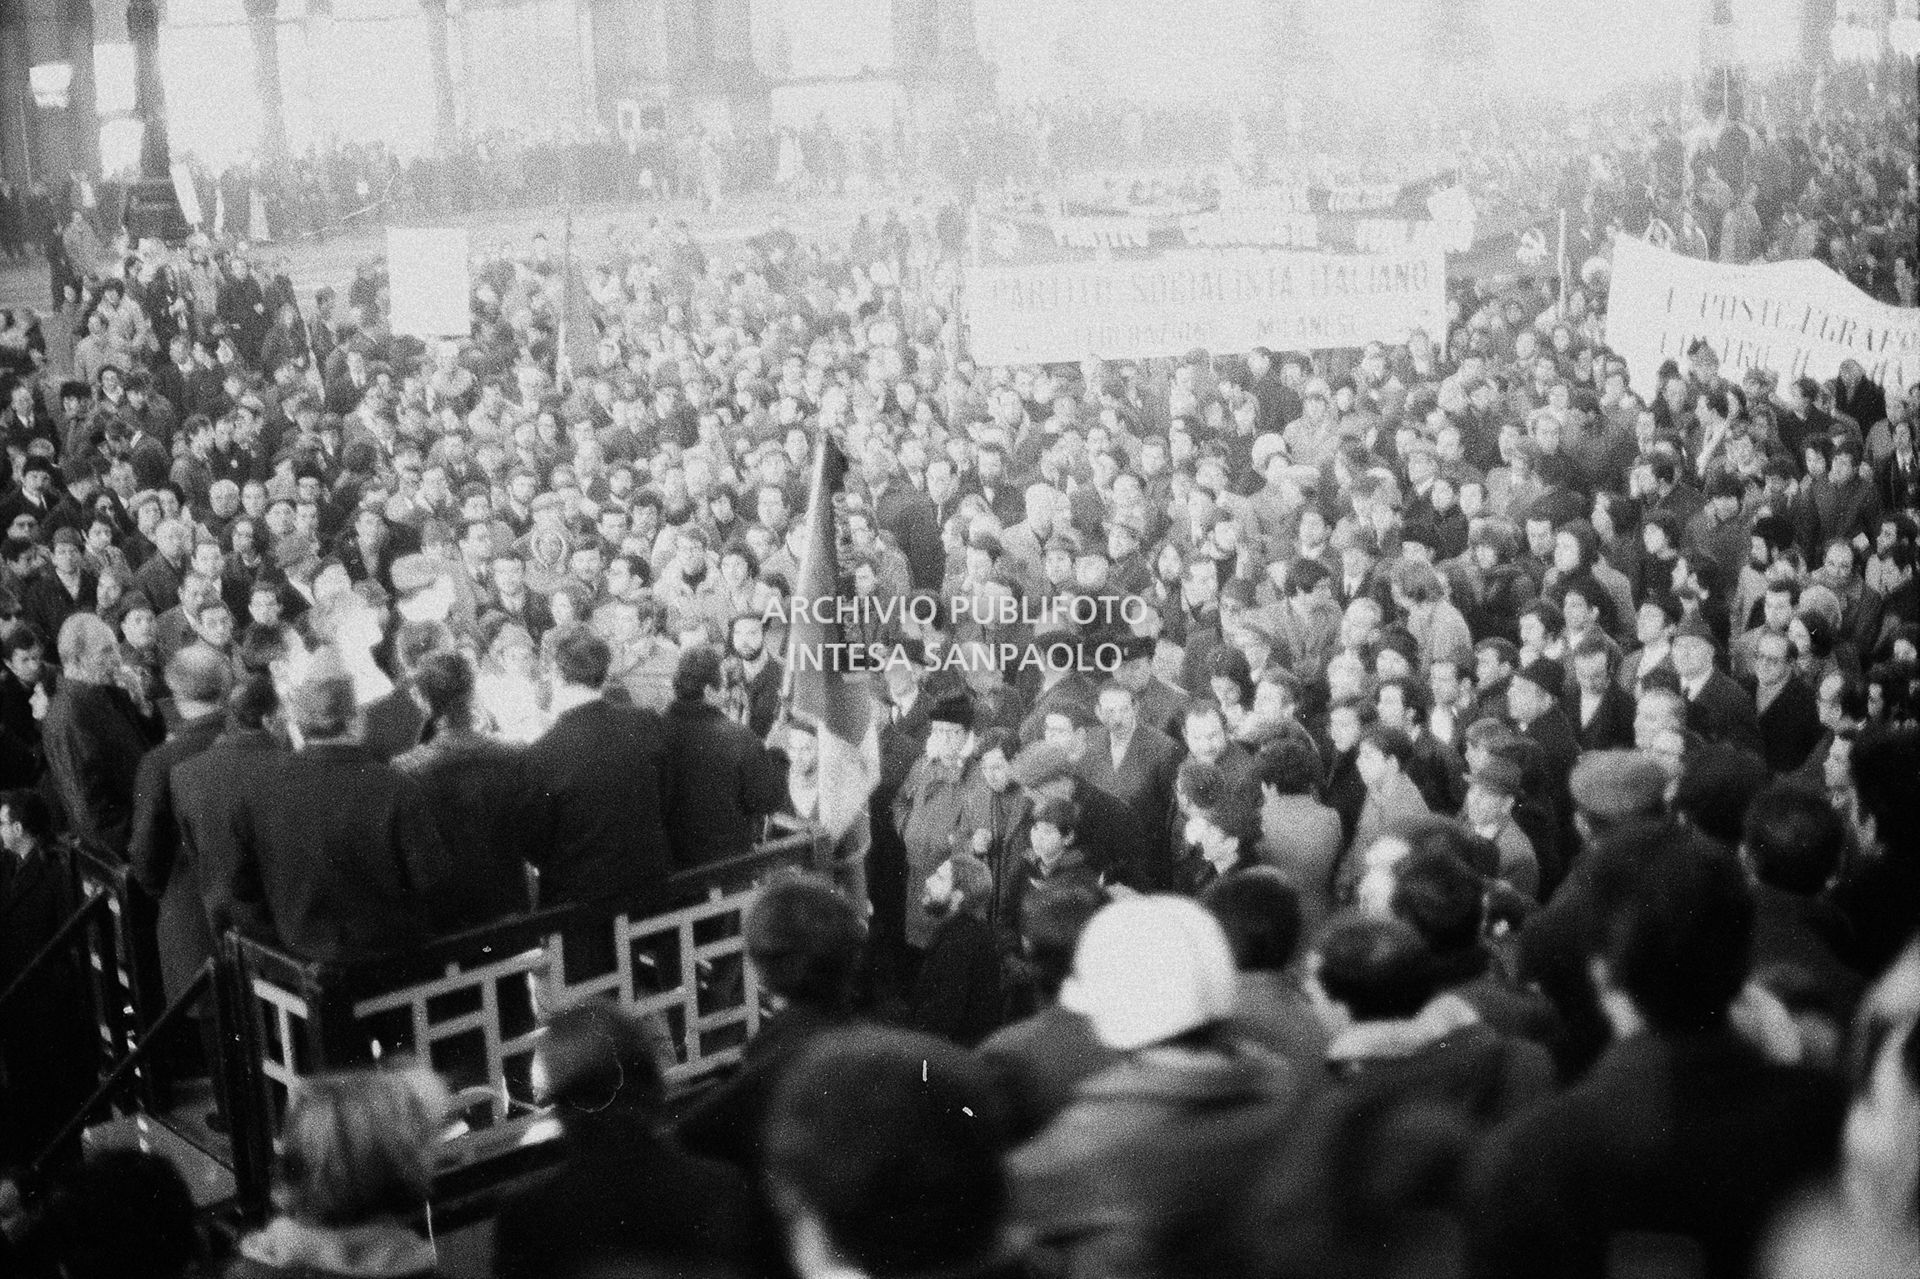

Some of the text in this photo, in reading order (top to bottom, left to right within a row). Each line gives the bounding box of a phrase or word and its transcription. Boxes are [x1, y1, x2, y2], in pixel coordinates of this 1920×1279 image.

[992, 259, 1429, 311] PARTITO SOCIALISTA ITALIANO
